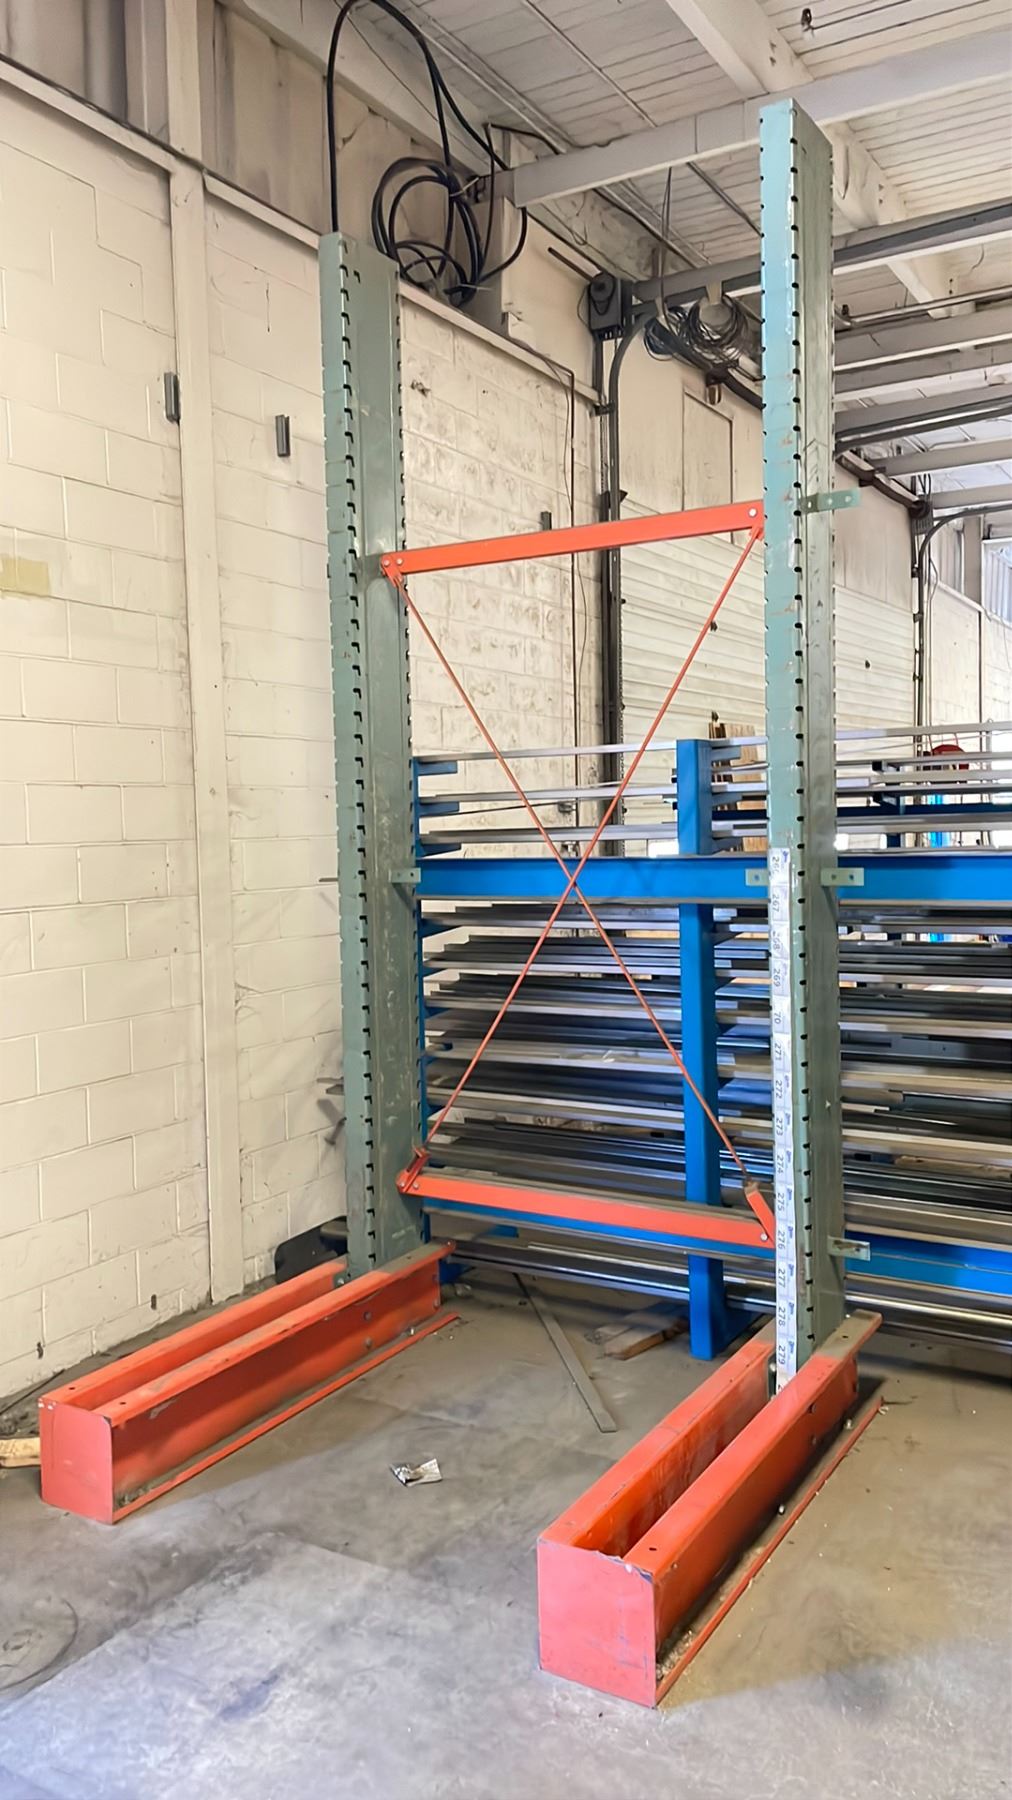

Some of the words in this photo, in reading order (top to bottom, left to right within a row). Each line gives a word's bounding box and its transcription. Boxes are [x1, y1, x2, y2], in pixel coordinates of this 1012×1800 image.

[772, 894, 780, 912] 267
[773, 968, 781, 987] 269
[775, 1079, 783, 1099] 272
[775, 1117, 783, 1136] 273
[776, 1154, 784, 1173] 274
[777, 1192, 785, 1211] 275
[777, 1231, 785, 1250] 276
[778, 1307, 786, 1326] 278
[778, 1345, 786, 1365] 279
